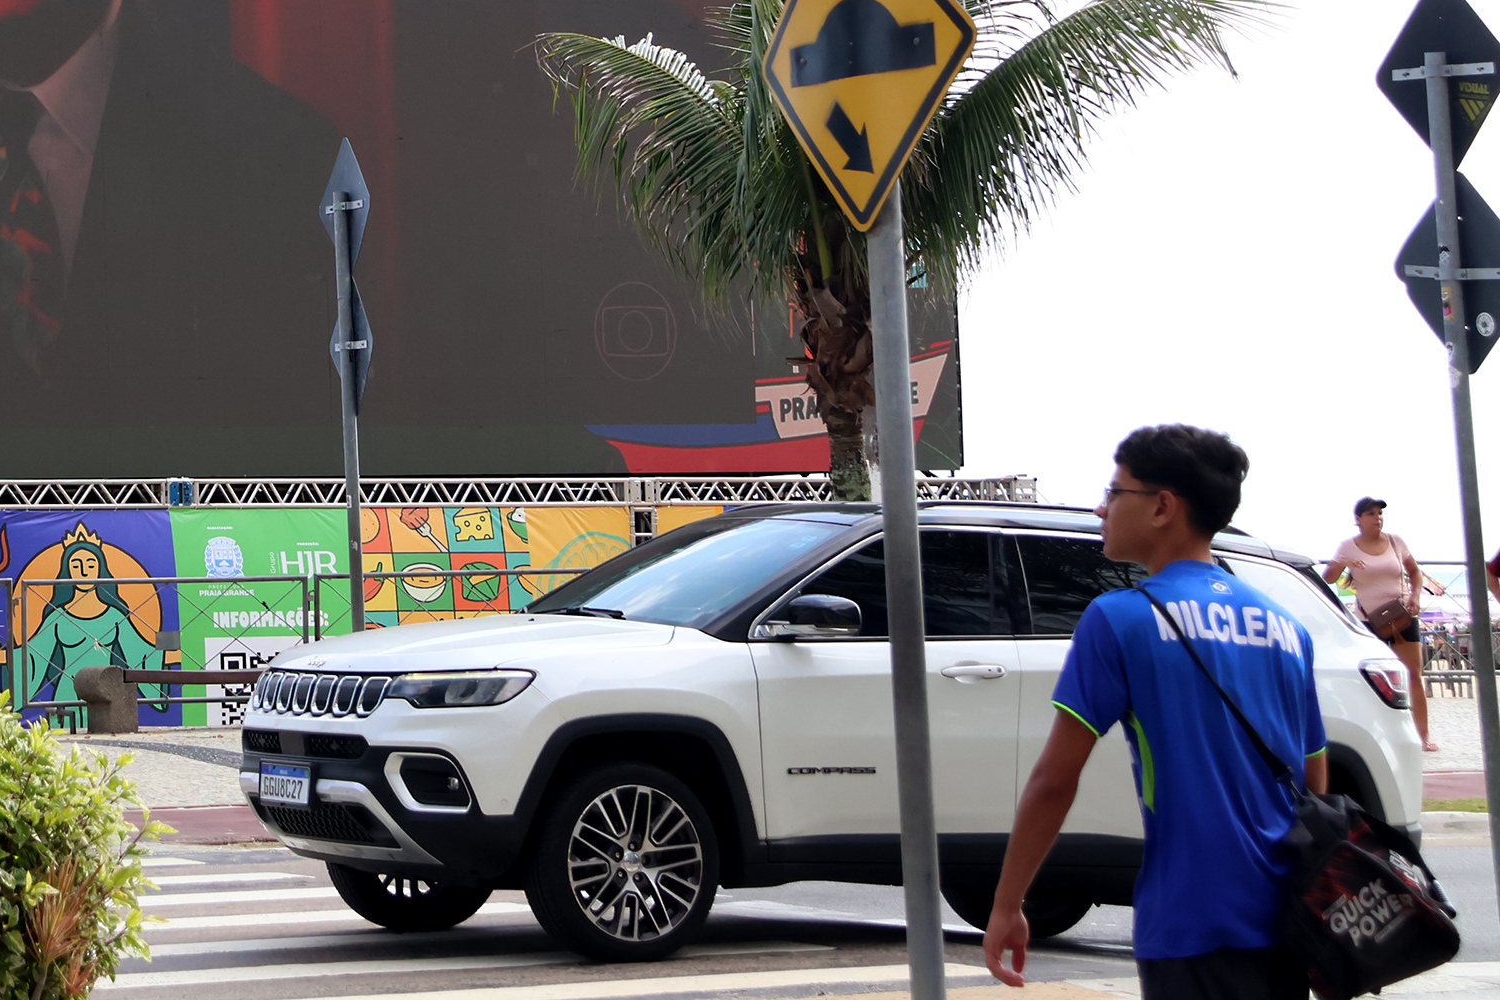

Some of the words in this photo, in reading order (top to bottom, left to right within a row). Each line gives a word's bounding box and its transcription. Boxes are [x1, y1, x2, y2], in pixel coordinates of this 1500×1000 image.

[269, 551, 277, 574] Grupo
[279, 550, 338, 579] HJR
[199, 589, 223, 597] PRAIA
[223, 589, 255, 597] GRANDE
[786, 766, 877, 775] COMPASS
[1329, 878, 1387, 934] QUICK
[1348, 893, 1415, 947] POWER
